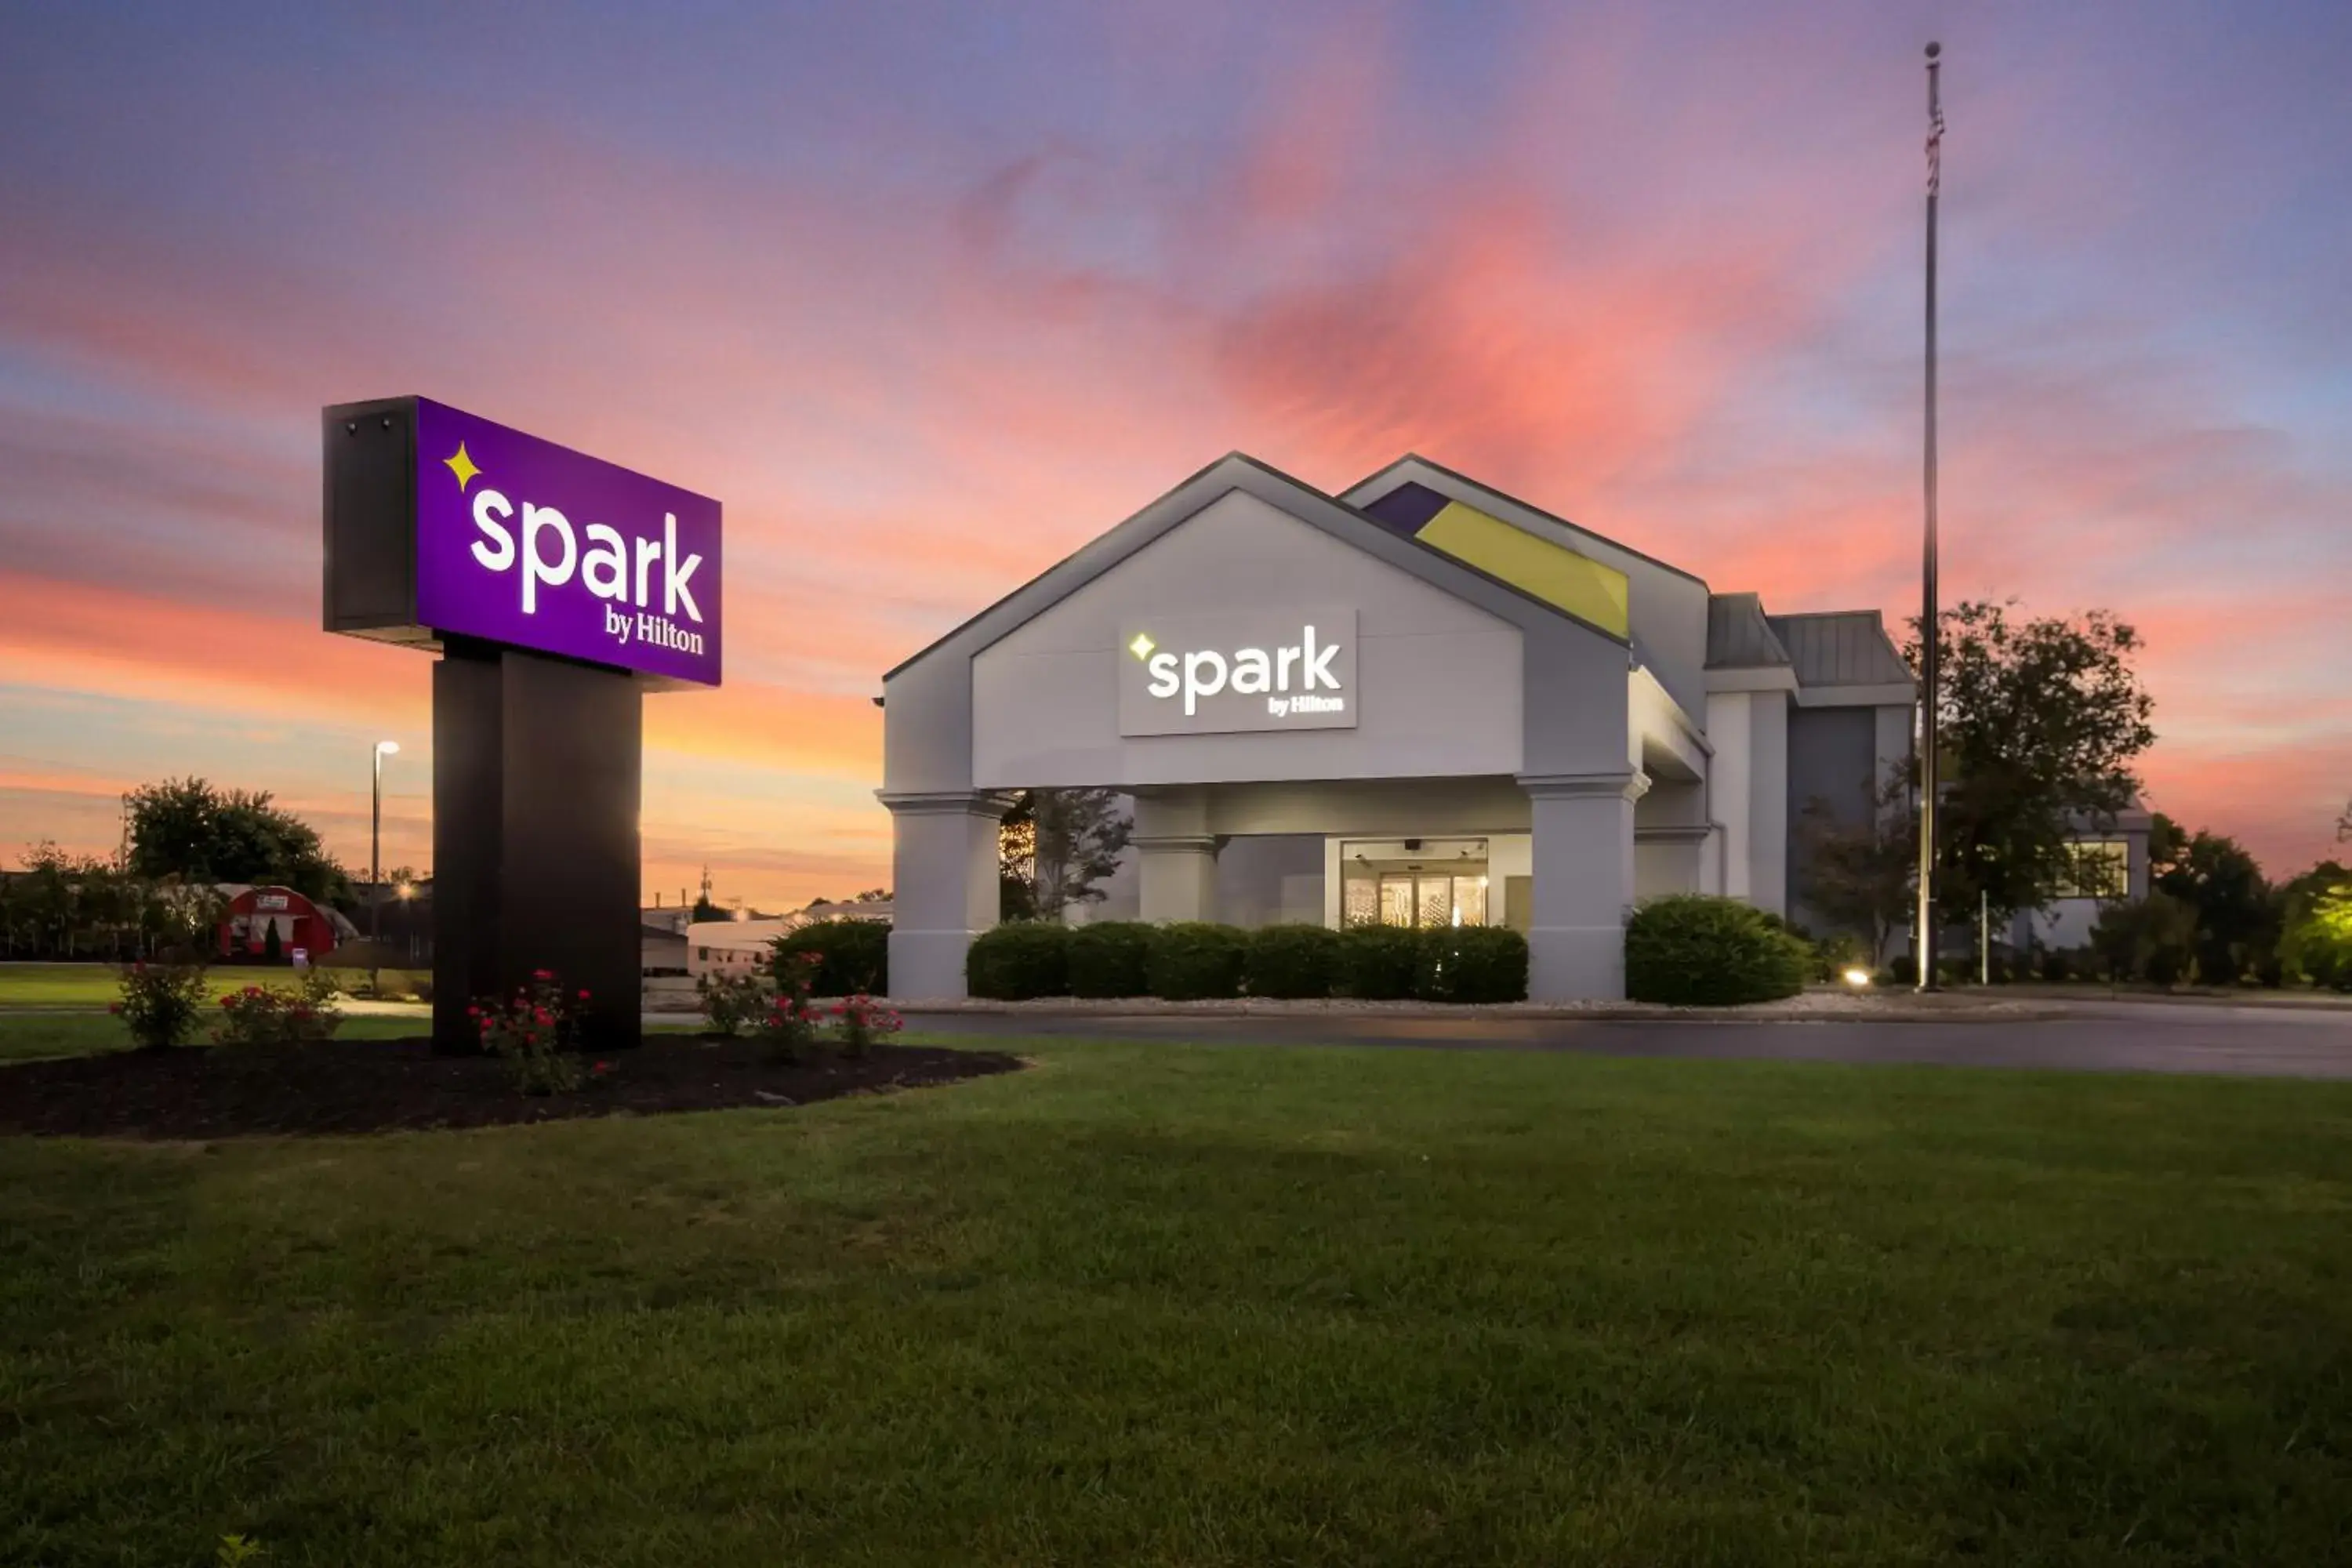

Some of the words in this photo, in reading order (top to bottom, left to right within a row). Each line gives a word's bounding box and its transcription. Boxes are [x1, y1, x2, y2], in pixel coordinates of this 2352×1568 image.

[470, 488, 702, 622] spark
[605, 603, 633, 644] by
[637, 612, 703, 655] Hilton
[1147, 625, 1341, 716] spark
[1268, 696, 1290, 717] by
[1290, 695, 1345, 713] Hilton
